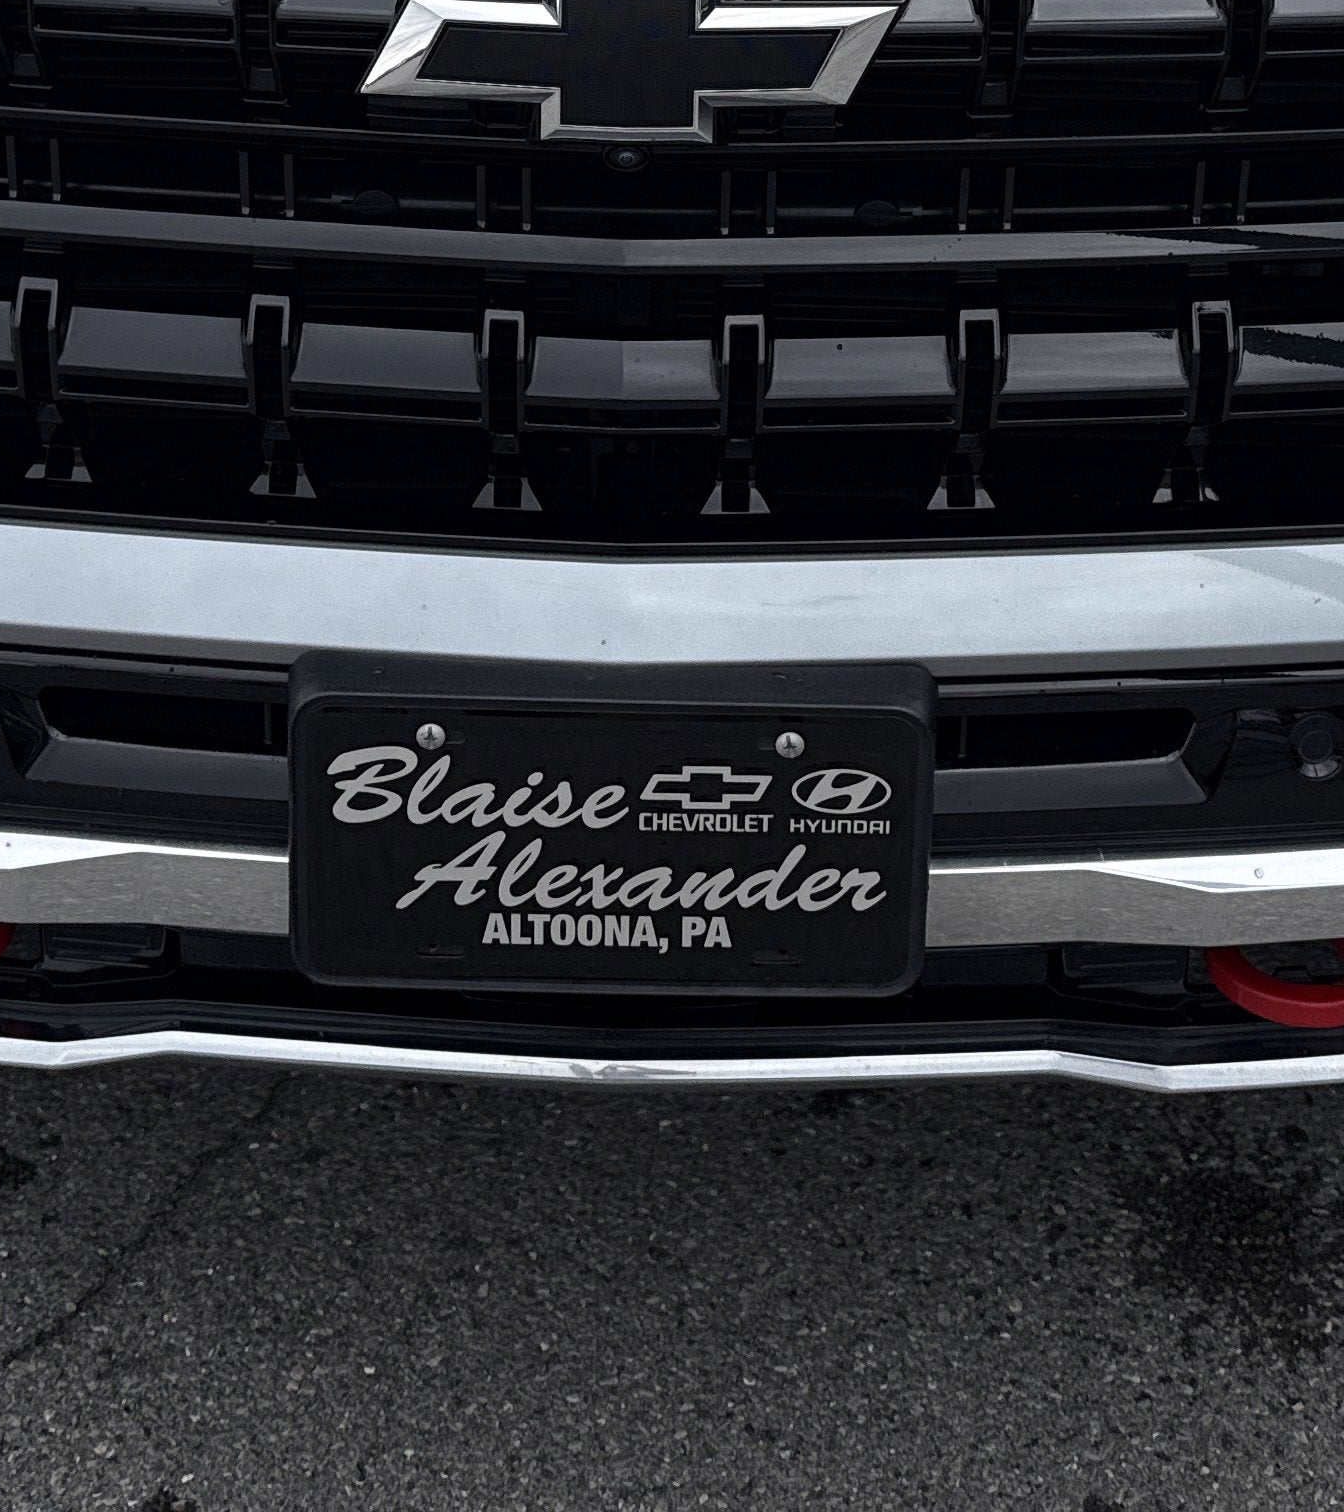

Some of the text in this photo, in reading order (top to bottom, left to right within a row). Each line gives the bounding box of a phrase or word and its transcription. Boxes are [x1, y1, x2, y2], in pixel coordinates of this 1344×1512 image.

[326, 745, 630, 829] Blaise
[638, 812, 774, 833] CHEVROLET
[789, 818, 891, 835] HYUNDAI
[395, 830, 887, 912] Alexander
[481, 912, 733, 954] ALTOONA, PA
